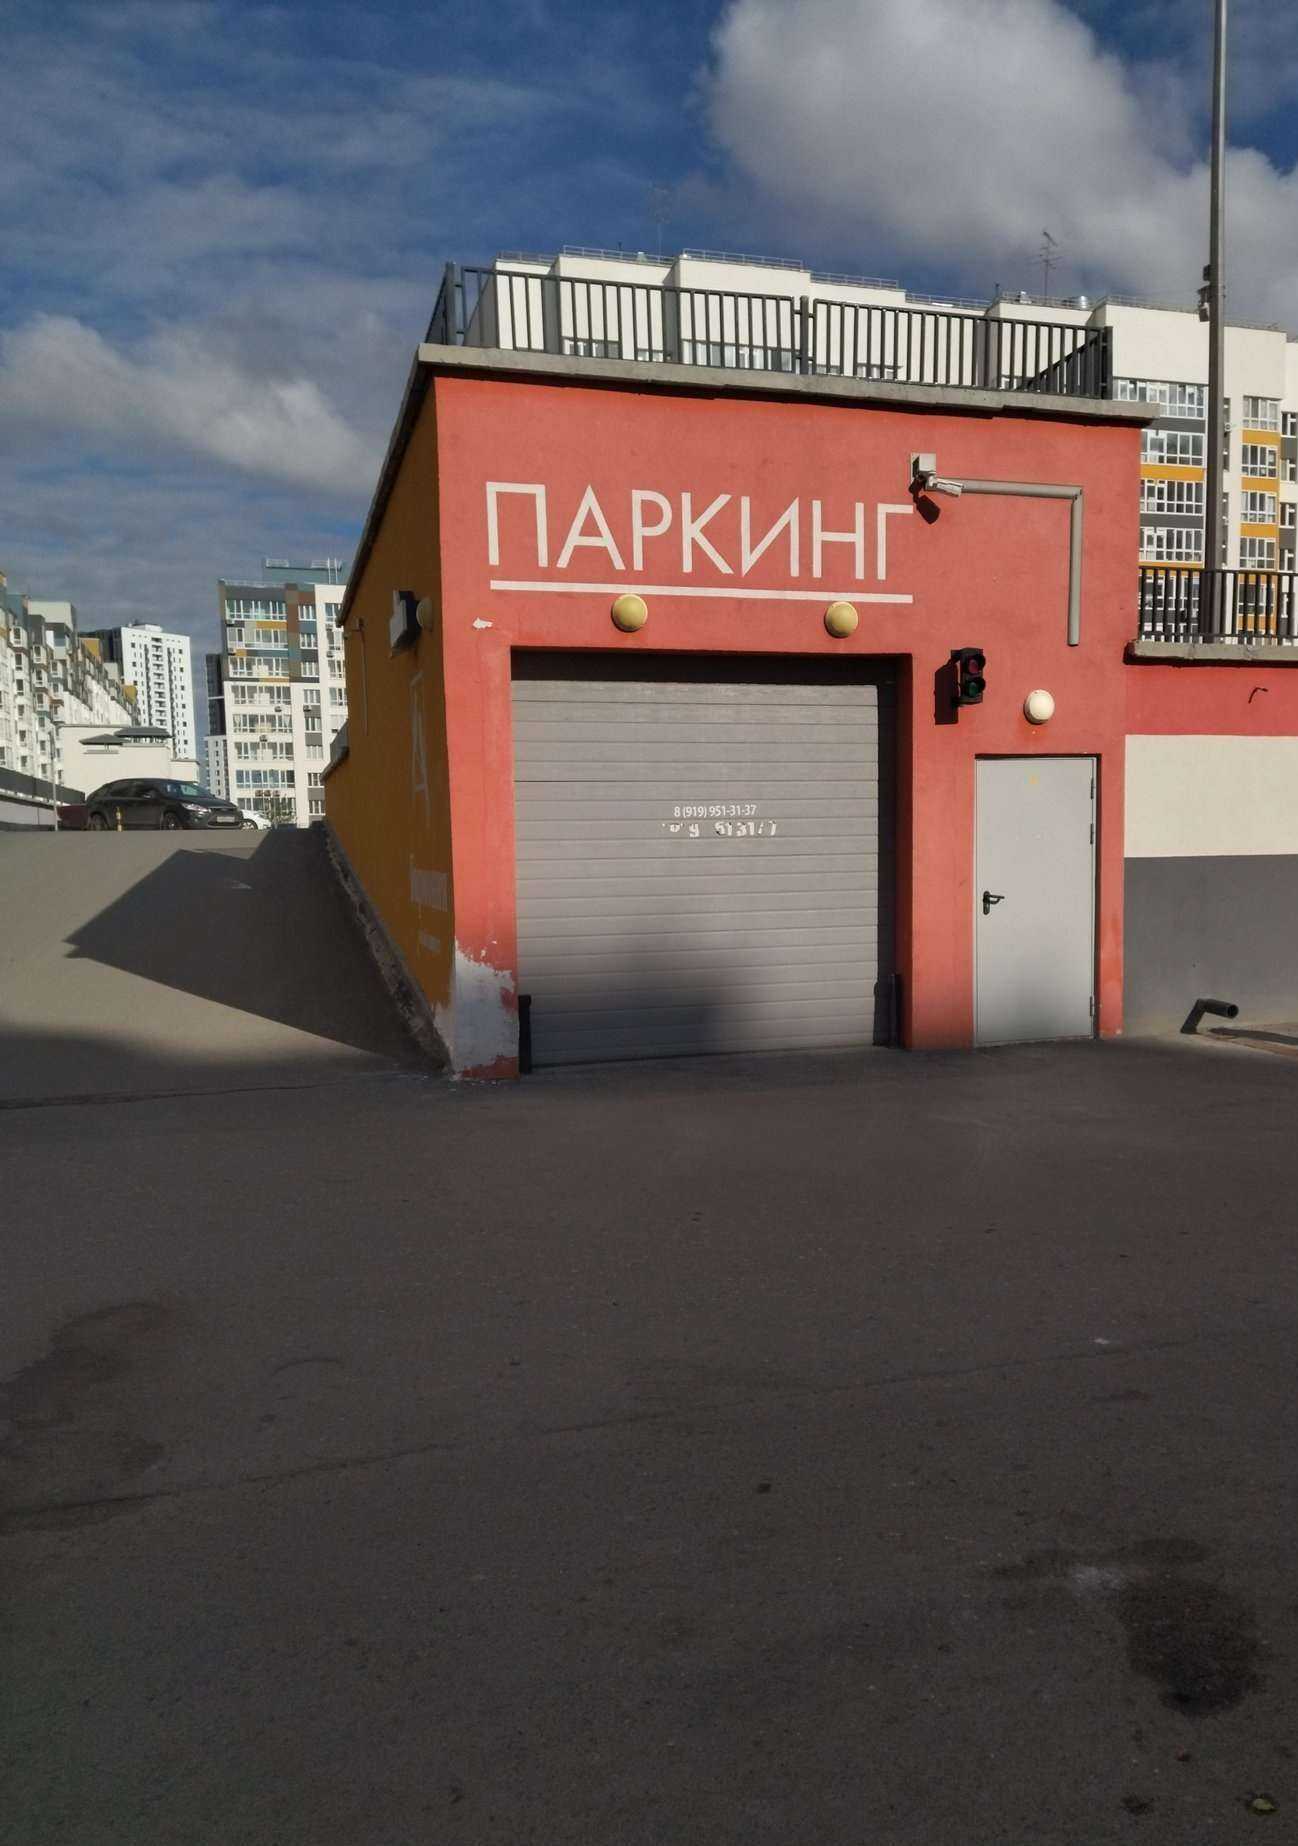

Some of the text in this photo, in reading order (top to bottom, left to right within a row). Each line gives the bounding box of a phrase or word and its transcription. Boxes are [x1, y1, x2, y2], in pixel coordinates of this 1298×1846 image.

[486, 481, 913, 580] ПАРКИНГ
[674, 803, 757, 819] 8 (919) 951-31-37
